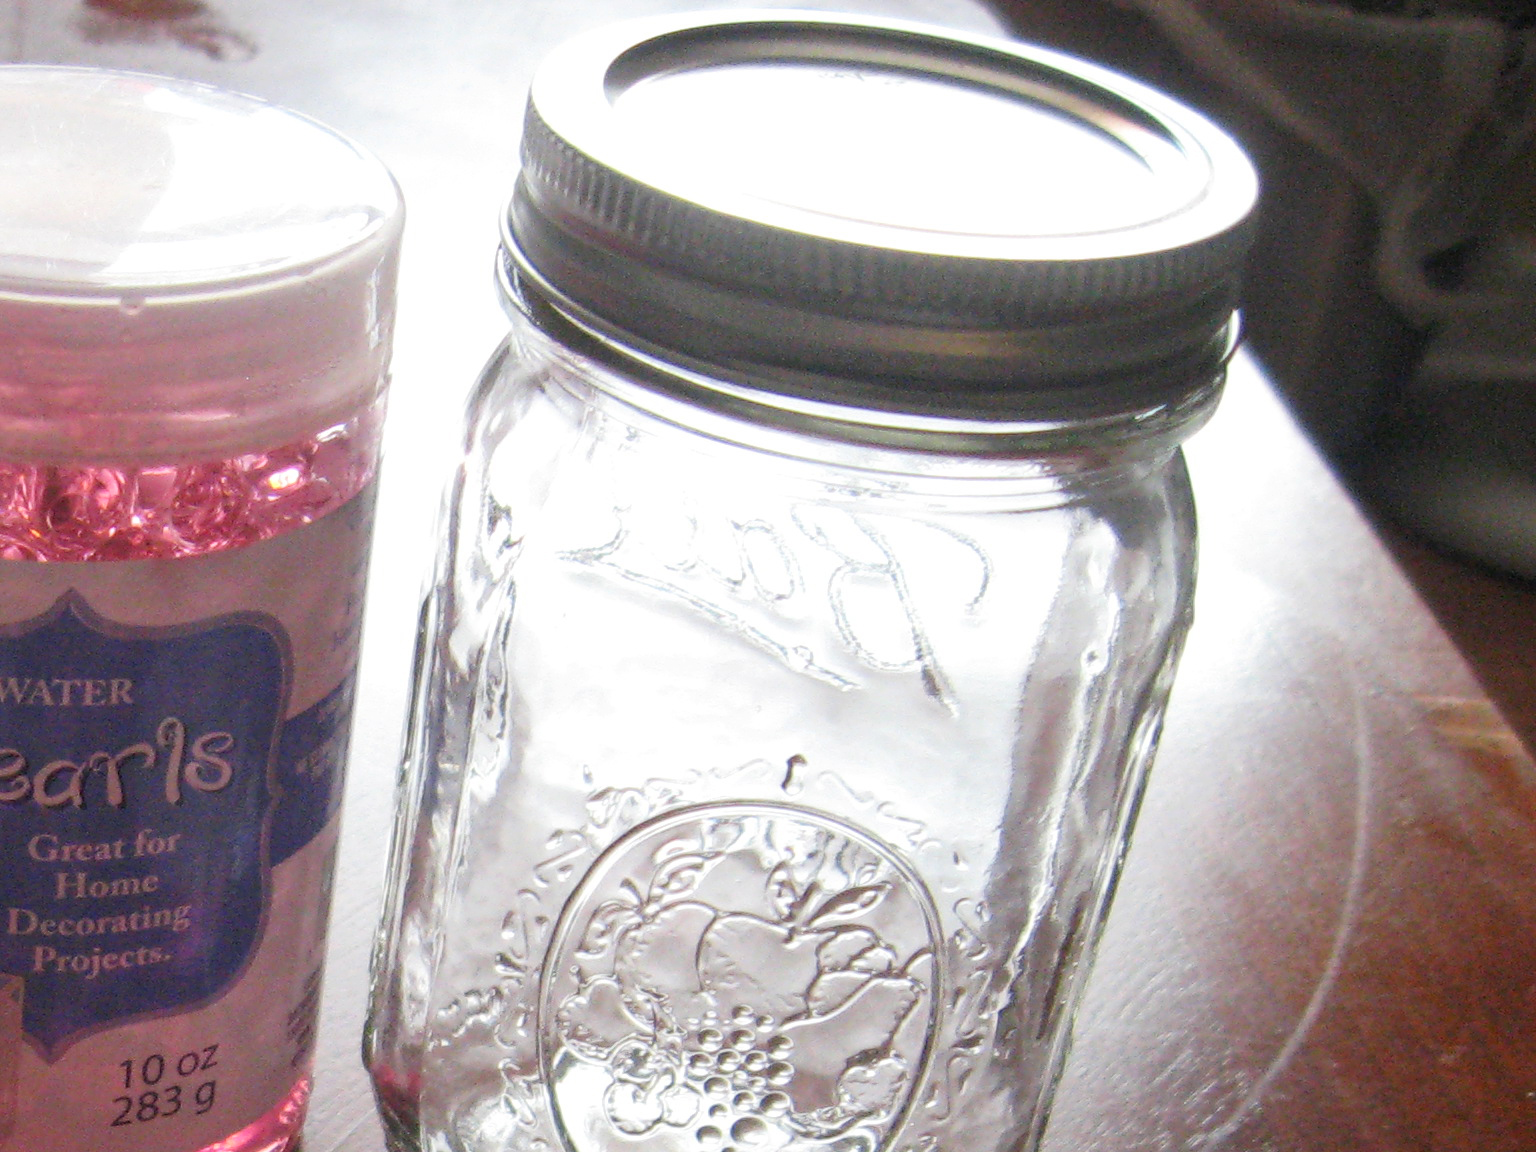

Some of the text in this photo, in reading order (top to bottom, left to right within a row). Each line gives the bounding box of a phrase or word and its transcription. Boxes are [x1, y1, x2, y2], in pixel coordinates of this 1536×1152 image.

[28, 828, 182, 862] Great for
[55, 871, 159, 900] Home
[7, 903, 192, 936] Decorating
[34, 946, 171, 980] Projects.
[120, 1044, 219, 1089] 10 oz
[111, 1080, 217, 1127] 283 g
